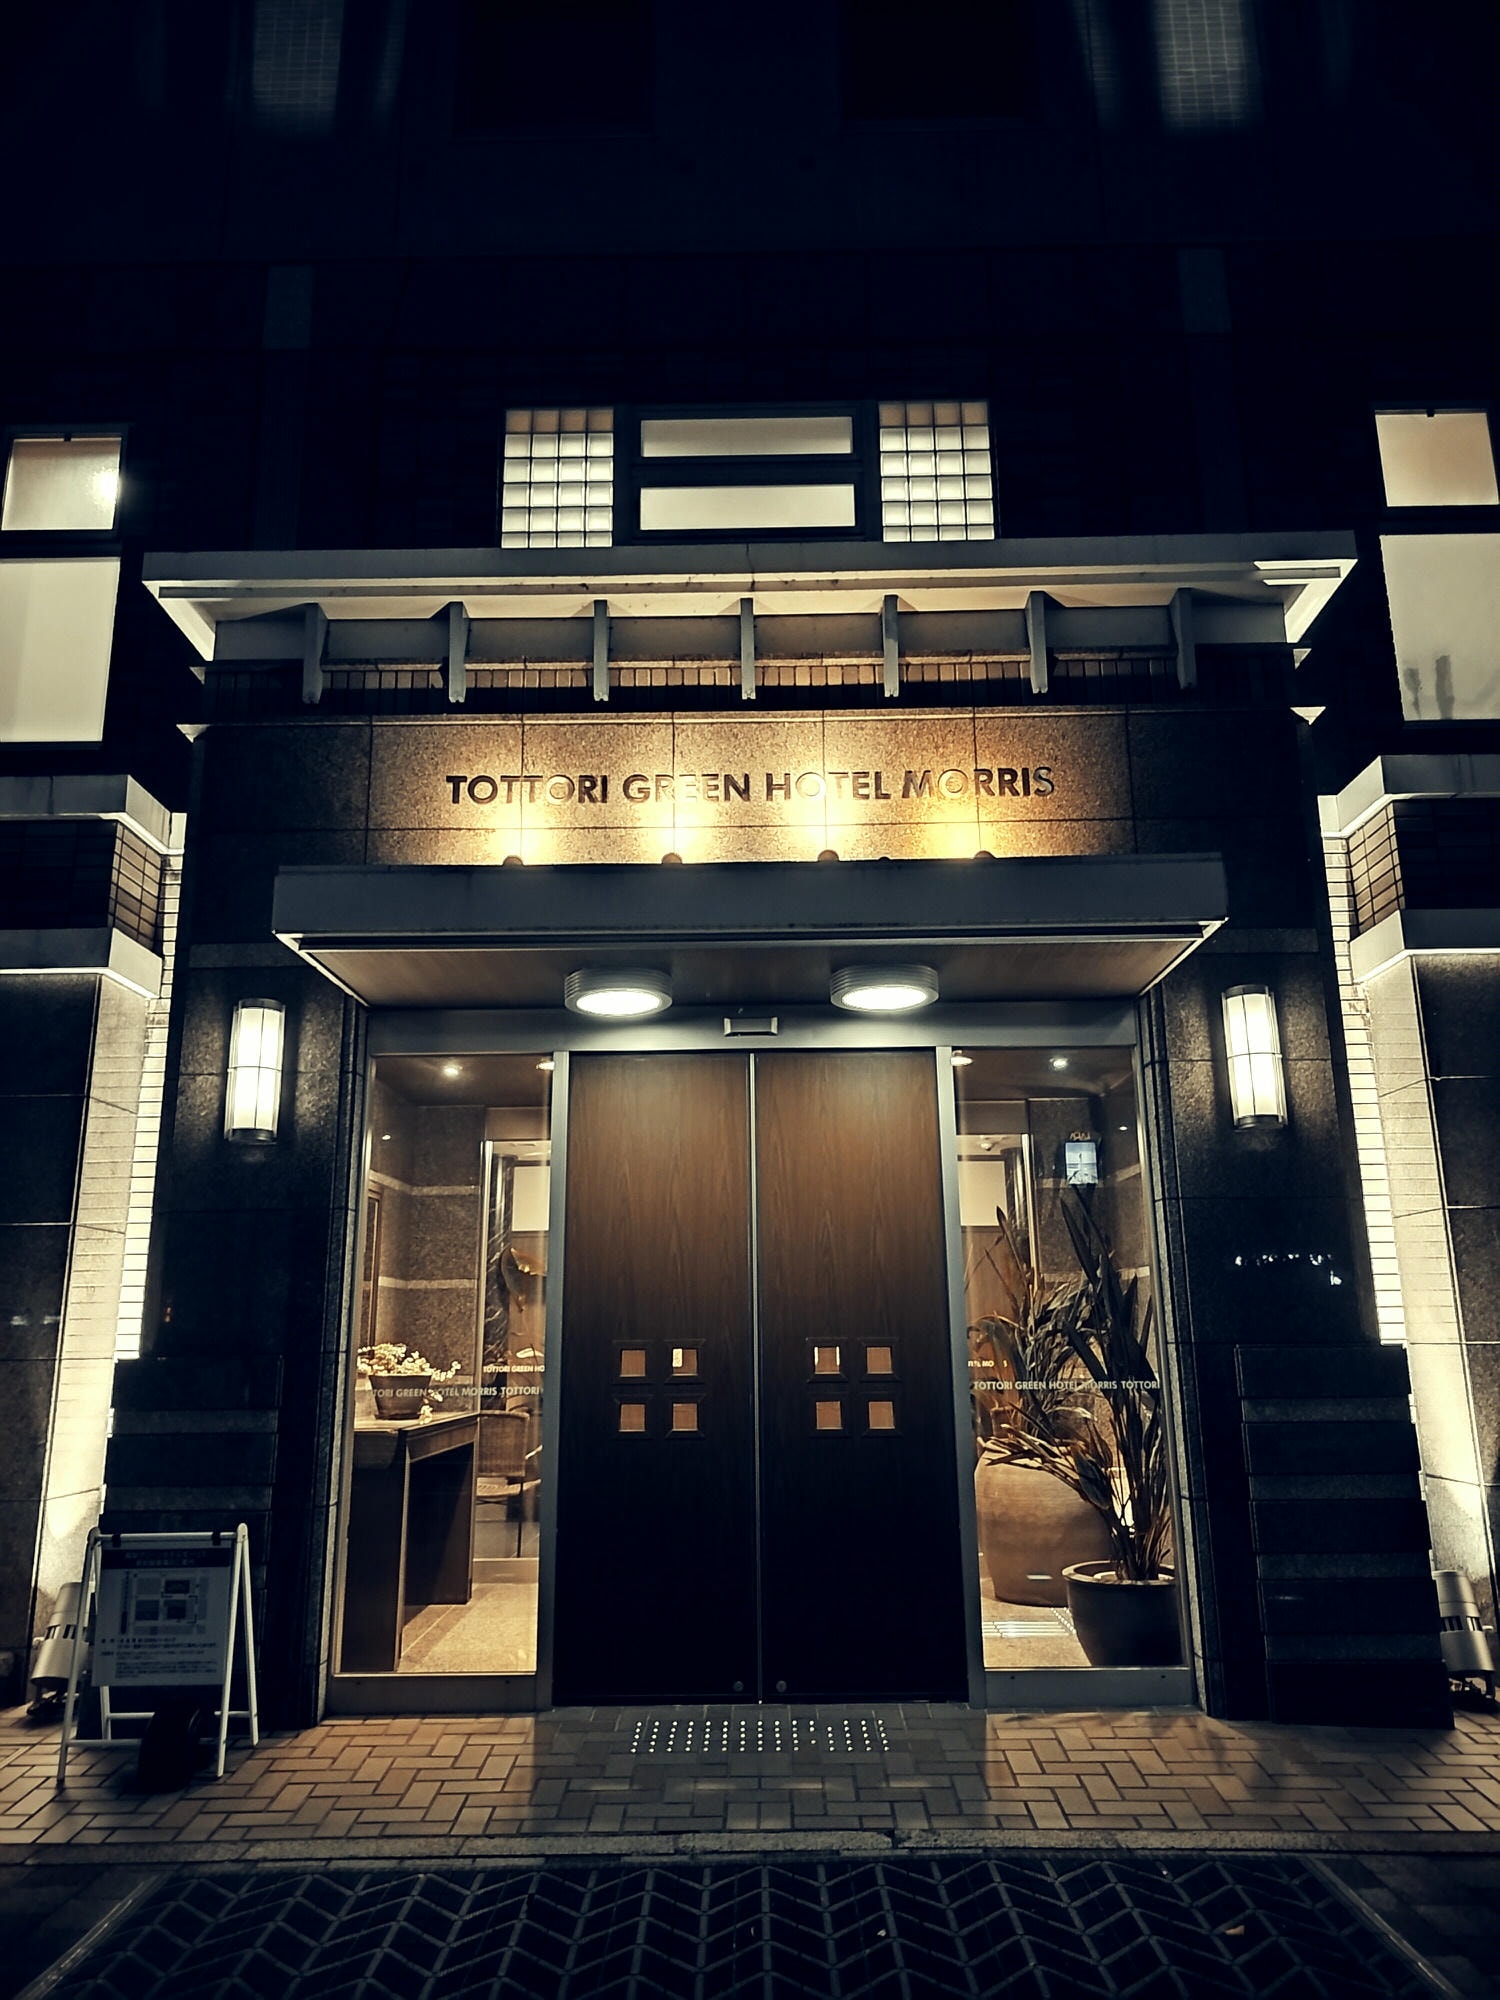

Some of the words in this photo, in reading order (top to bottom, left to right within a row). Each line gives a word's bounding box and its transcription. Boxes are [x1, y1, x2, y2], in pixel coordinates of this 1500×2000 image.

[446, 775, 608, 805] TOTTORI
[622, 773, 751, 803] GREEN
[765, 771, 891, 801] HOTEL
[902, 766, 1055, 800] MORRIS
[973, 1380, 1012, 1391] TOTTORI
[1014, 1380, 1046, 1390] GREEN
[1121, 1380, 1160, 1390] TOTTORI
[396, 1388, 427, 1397] GREEN
[432, 1387, 459, 1396] OTEL
[462, 1386, 498, 1396] MORRIS
[501, 1386, 540, 1396] TOTTORI
